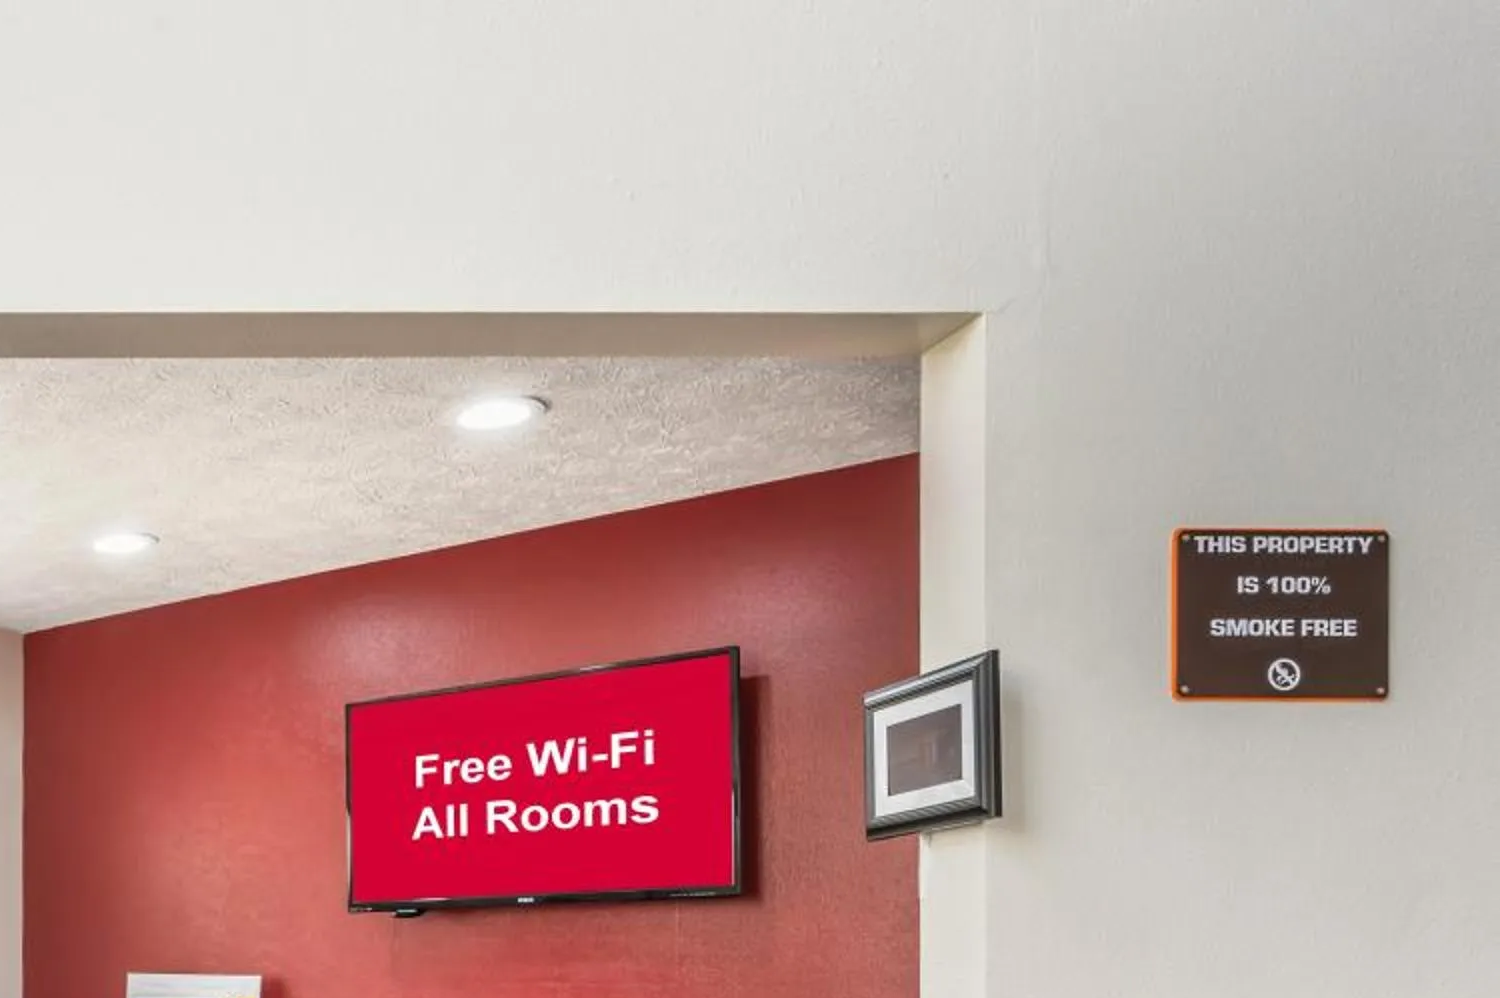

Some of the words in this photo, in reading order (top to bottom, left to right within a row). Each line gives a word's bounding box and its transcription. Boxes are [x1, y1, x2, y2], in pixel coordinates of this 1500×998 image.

[1193, 535, 1247, 554] THIS
[1252, 535, 1374, 554] PROPERTY
[1237, 576, 1259, 594] IS
[1266, 576, 1332, 594] 100%
[1210, 618, 1295, 637] SMOKE
[1301, 618, 1358, 637] FREE
[414, 753, 513, 789] Free
[526, 729, 656, 778] Wi-Fi
[411, 803, 468, 841] All
[485, 793, 660, 834] Rooms
